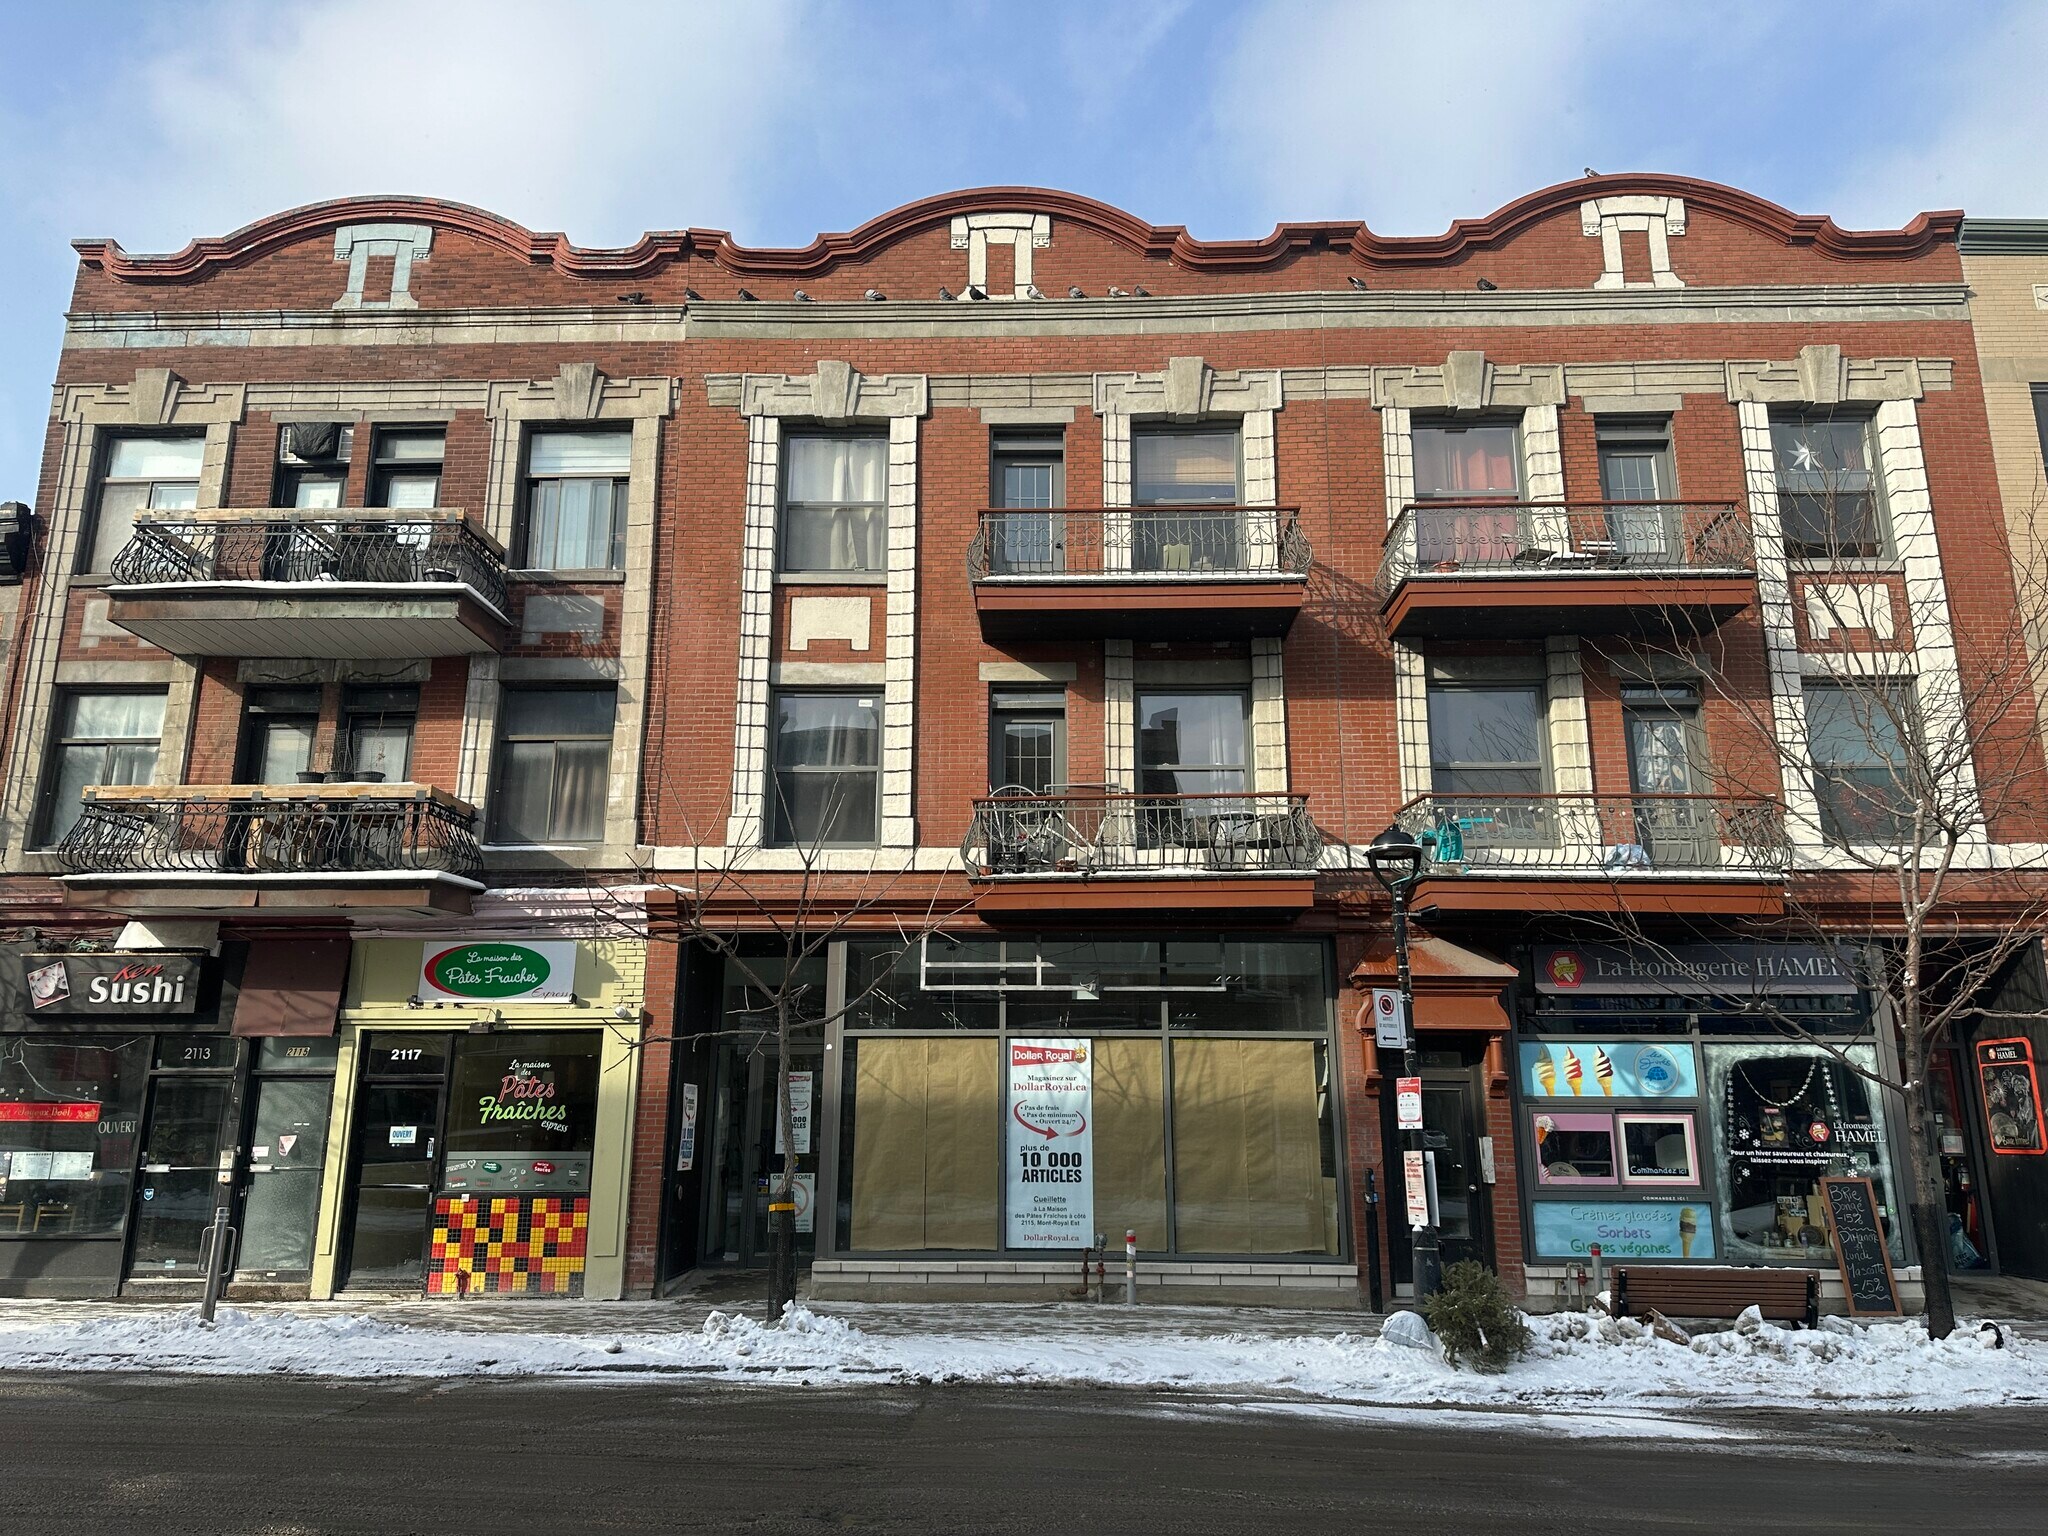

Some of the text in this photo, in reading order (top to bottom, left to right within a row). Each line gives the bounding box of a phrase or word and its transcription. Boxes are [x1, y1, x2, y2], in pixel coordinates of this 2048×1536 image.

[466, 952, 523, 963] La maison des
[112, 963, 164, 982] Ken
[1596, 958, 1622, 976] La
[1629, 957, 1750, 982] fromagerie
[88, 975, 186, 1004] Sushi
[531, 987, 569, 999] Express
[184, 1048, 211, 1060] 2113
[390, 1048, 422, 1060] 2117
[1045, 1050, 1072, 1062] Royal
[1997, 1051, 2018, 1060] HAMEL
[508, 1059, 551, 1070] La maison
[520, 1068, 532, 1076] des
[498, 1074, 555, 1103] Pâtes
[1014, 1083, 1086, 1092] DollarRoyal.ca
[479, 1096, 567, 1124] Fraîches
[98, 1120, 137, 1134] OUVERT
[541, 1120, 569, 1132] espress
[1844, 1122, 1881, 1131] fromagerie
[392, 1130, 412, 1138] OUVERT
[1835, 1130, 1887, 1142] HAMEL
[1020, 1144, 1037, 1152] plus
[1020, 1152, 1082, 1167] 10 000
[1813, 1151, 1849, 1159] chaleureux,
[1022, 1169, 1082, 1182] ARTICLES
[1630, 1166, 1677, 1174] Commandez
[1570, 1207, 1673, 1223] Crèmes glacées
[1837, 1213, 1863, 1224] -15%
[1024, 1234, 1079, 1242] DollarRoyal.ca
[1598, 1225, 1651, 1239] Sorbets
[1619, 1242, 1672, 1256] véganes
